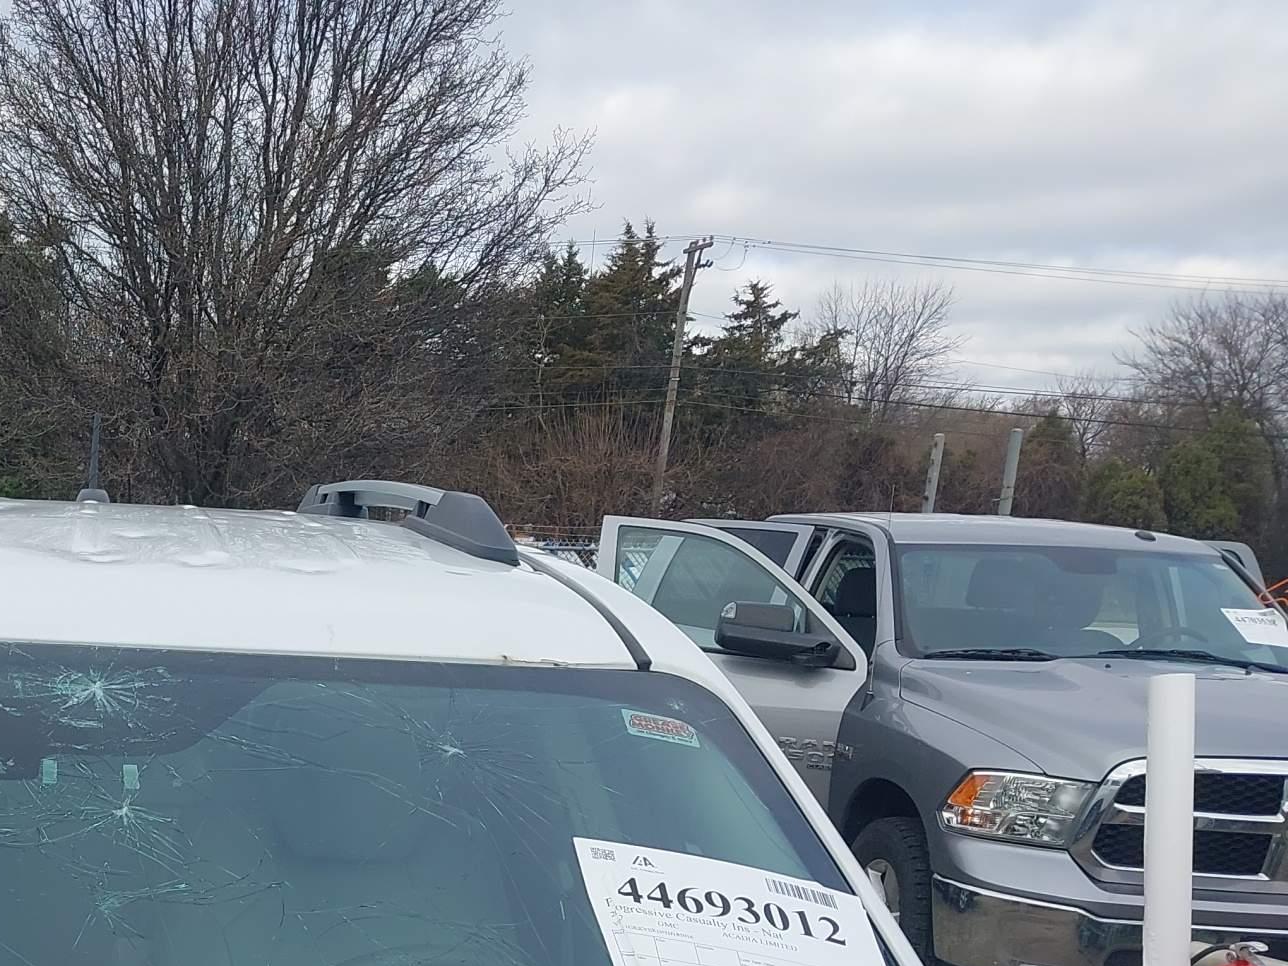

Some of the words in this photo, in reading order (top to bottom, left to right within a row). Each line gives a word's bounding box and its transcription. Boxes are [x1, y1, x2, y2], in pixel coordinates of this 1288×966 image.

[604, 897, 674, 919] Pogressive
[676, 912, 728, 930] Casualty
[732, 922, 751, 933] Ins
[762, 928, 784, 941] Nat
[618, 877, 847, 947] 44693012
[657, 921, 679, 929] GMC
[760, 938, 799, 952] LIMITED
